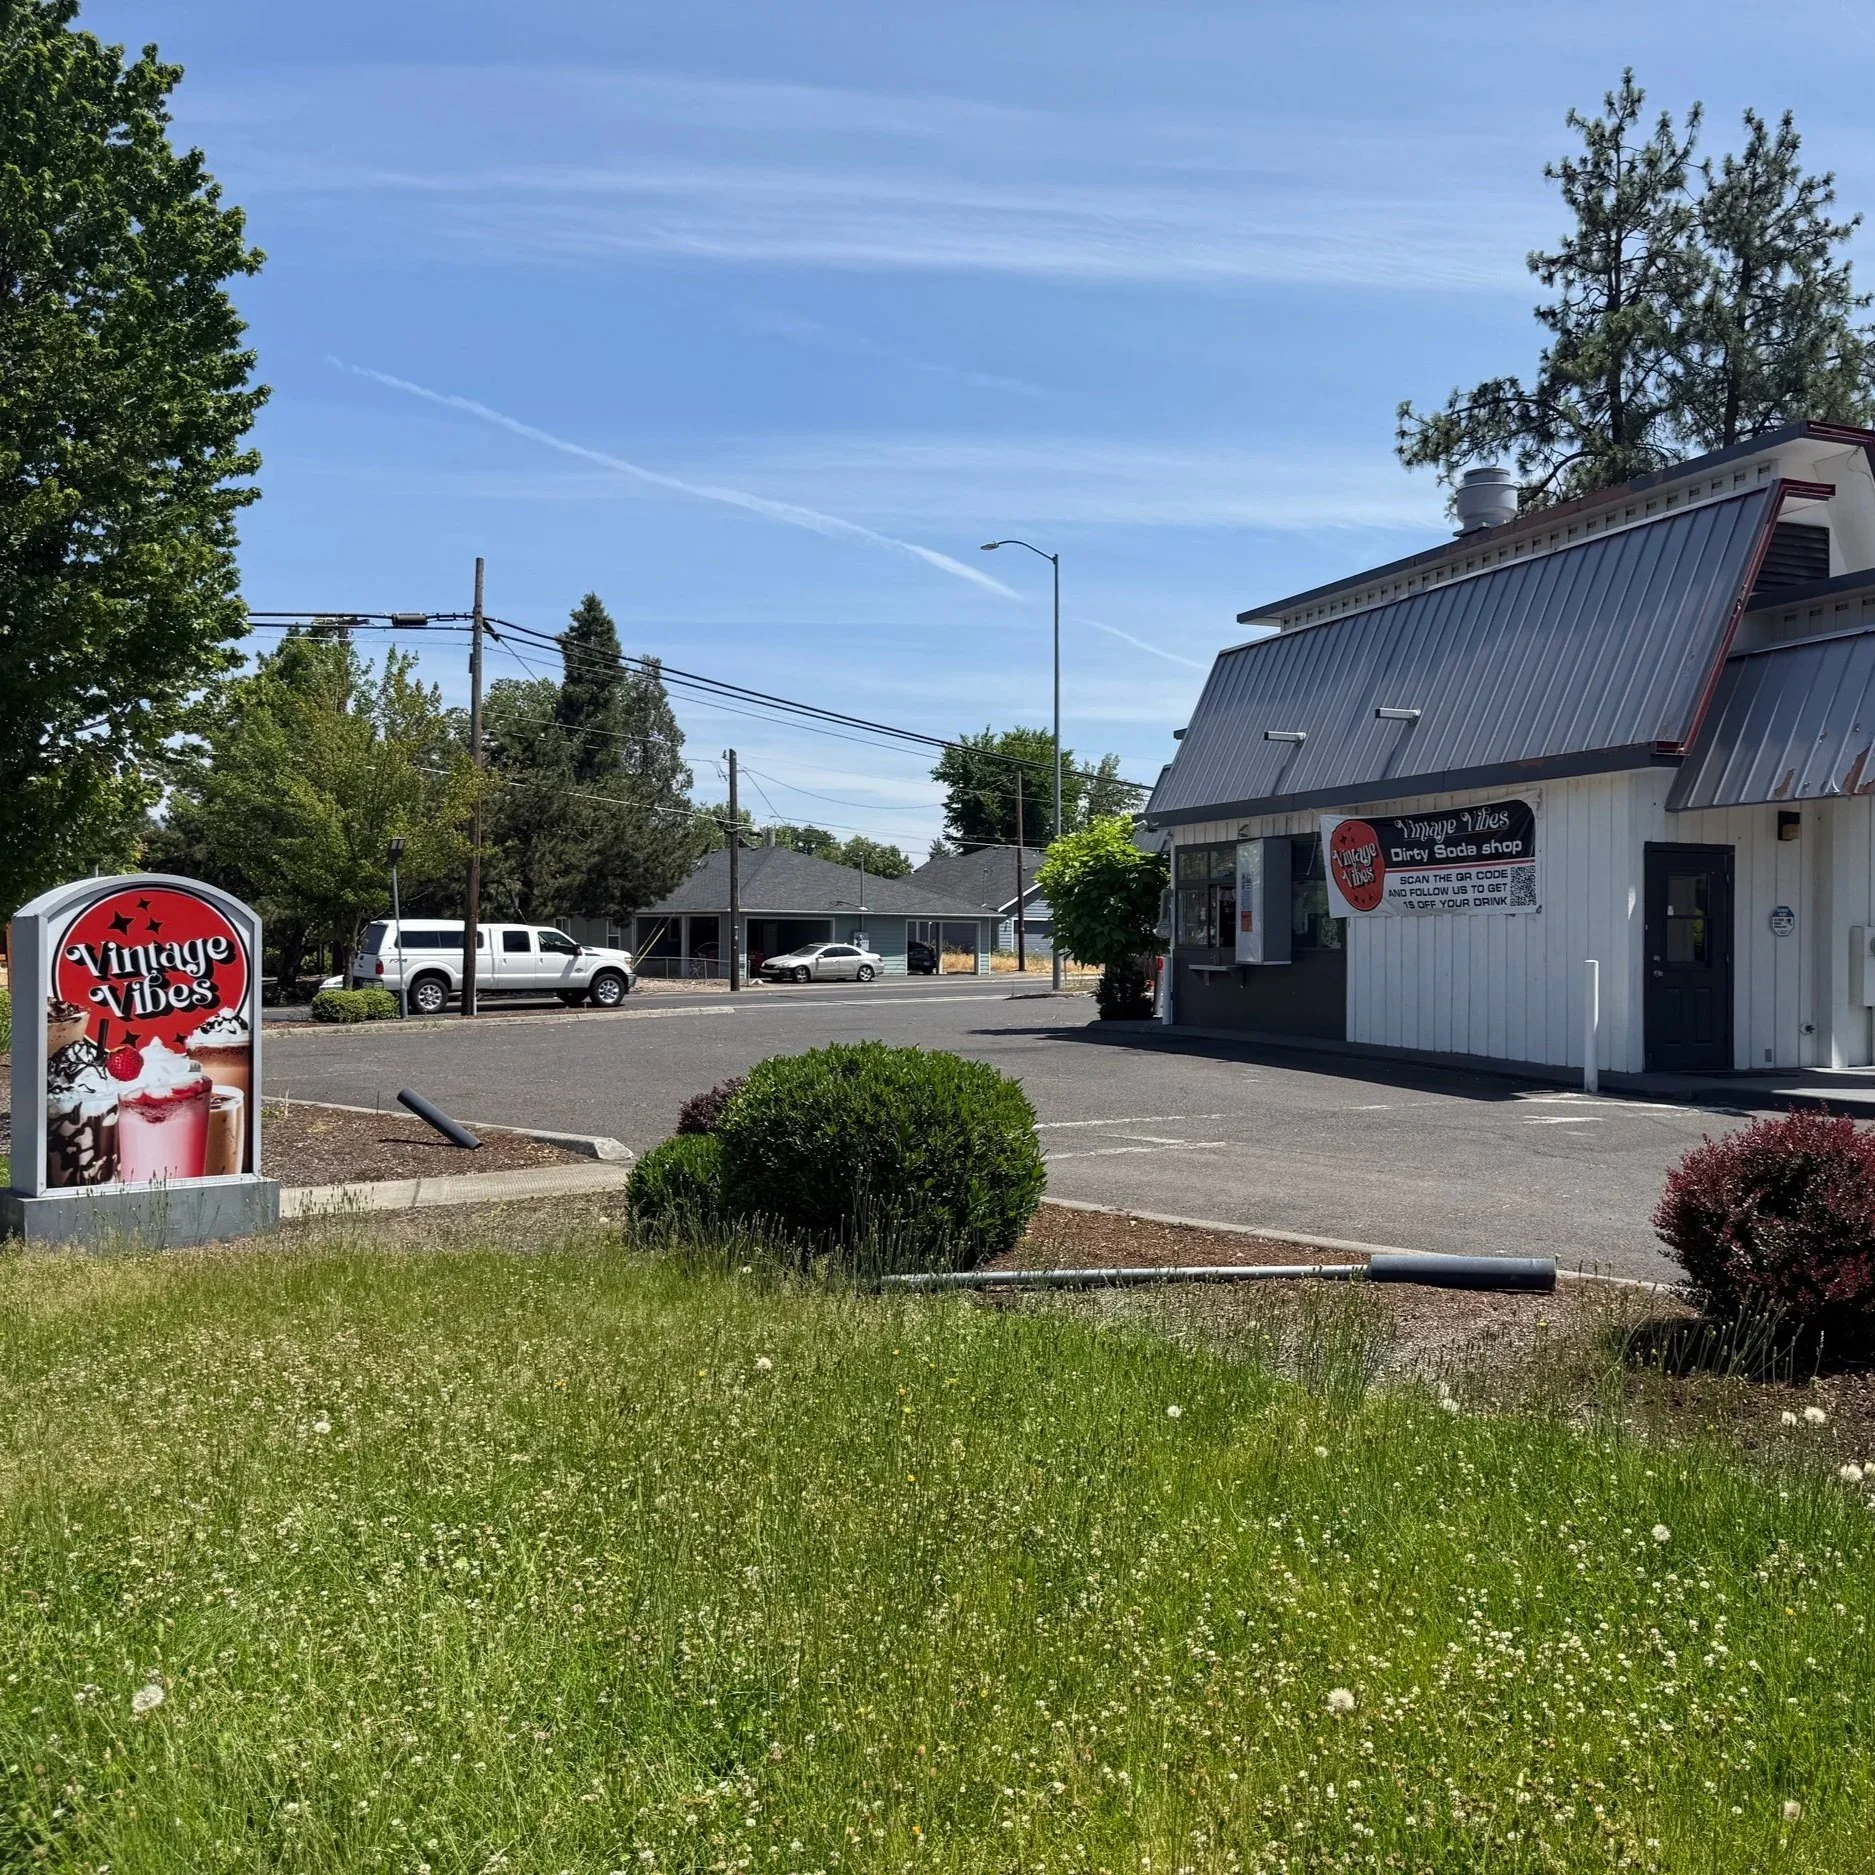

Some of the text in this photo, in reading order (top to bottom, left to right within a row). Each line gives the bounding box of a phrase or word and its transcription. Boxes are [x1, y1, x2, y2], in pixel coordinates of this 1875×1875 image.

[1394, 806, 1510, 843] Vintage Vibes
[1331, 842, 1377, 867] Vintage
[1390, 840, 1523, 862] Dirty Soda shop
[1341, 863, 1375, 888] Vibes
[1400, 875, 1430, 885] SCAN
[1433, 873, 1452, 883] THE
[1476, 869, 1508, 880] CODE
[1388, 883, 1508, 898] AND FOLLOW US TO GET
[1417, 900, 1437, 909] OFF
[1440, 899, 1470, 908] YOUR
[1473, 896, 1508, 907] DRINK
[65, 935, 229, 977] Vintage
[88, 970, 214, 1017] Vibes
